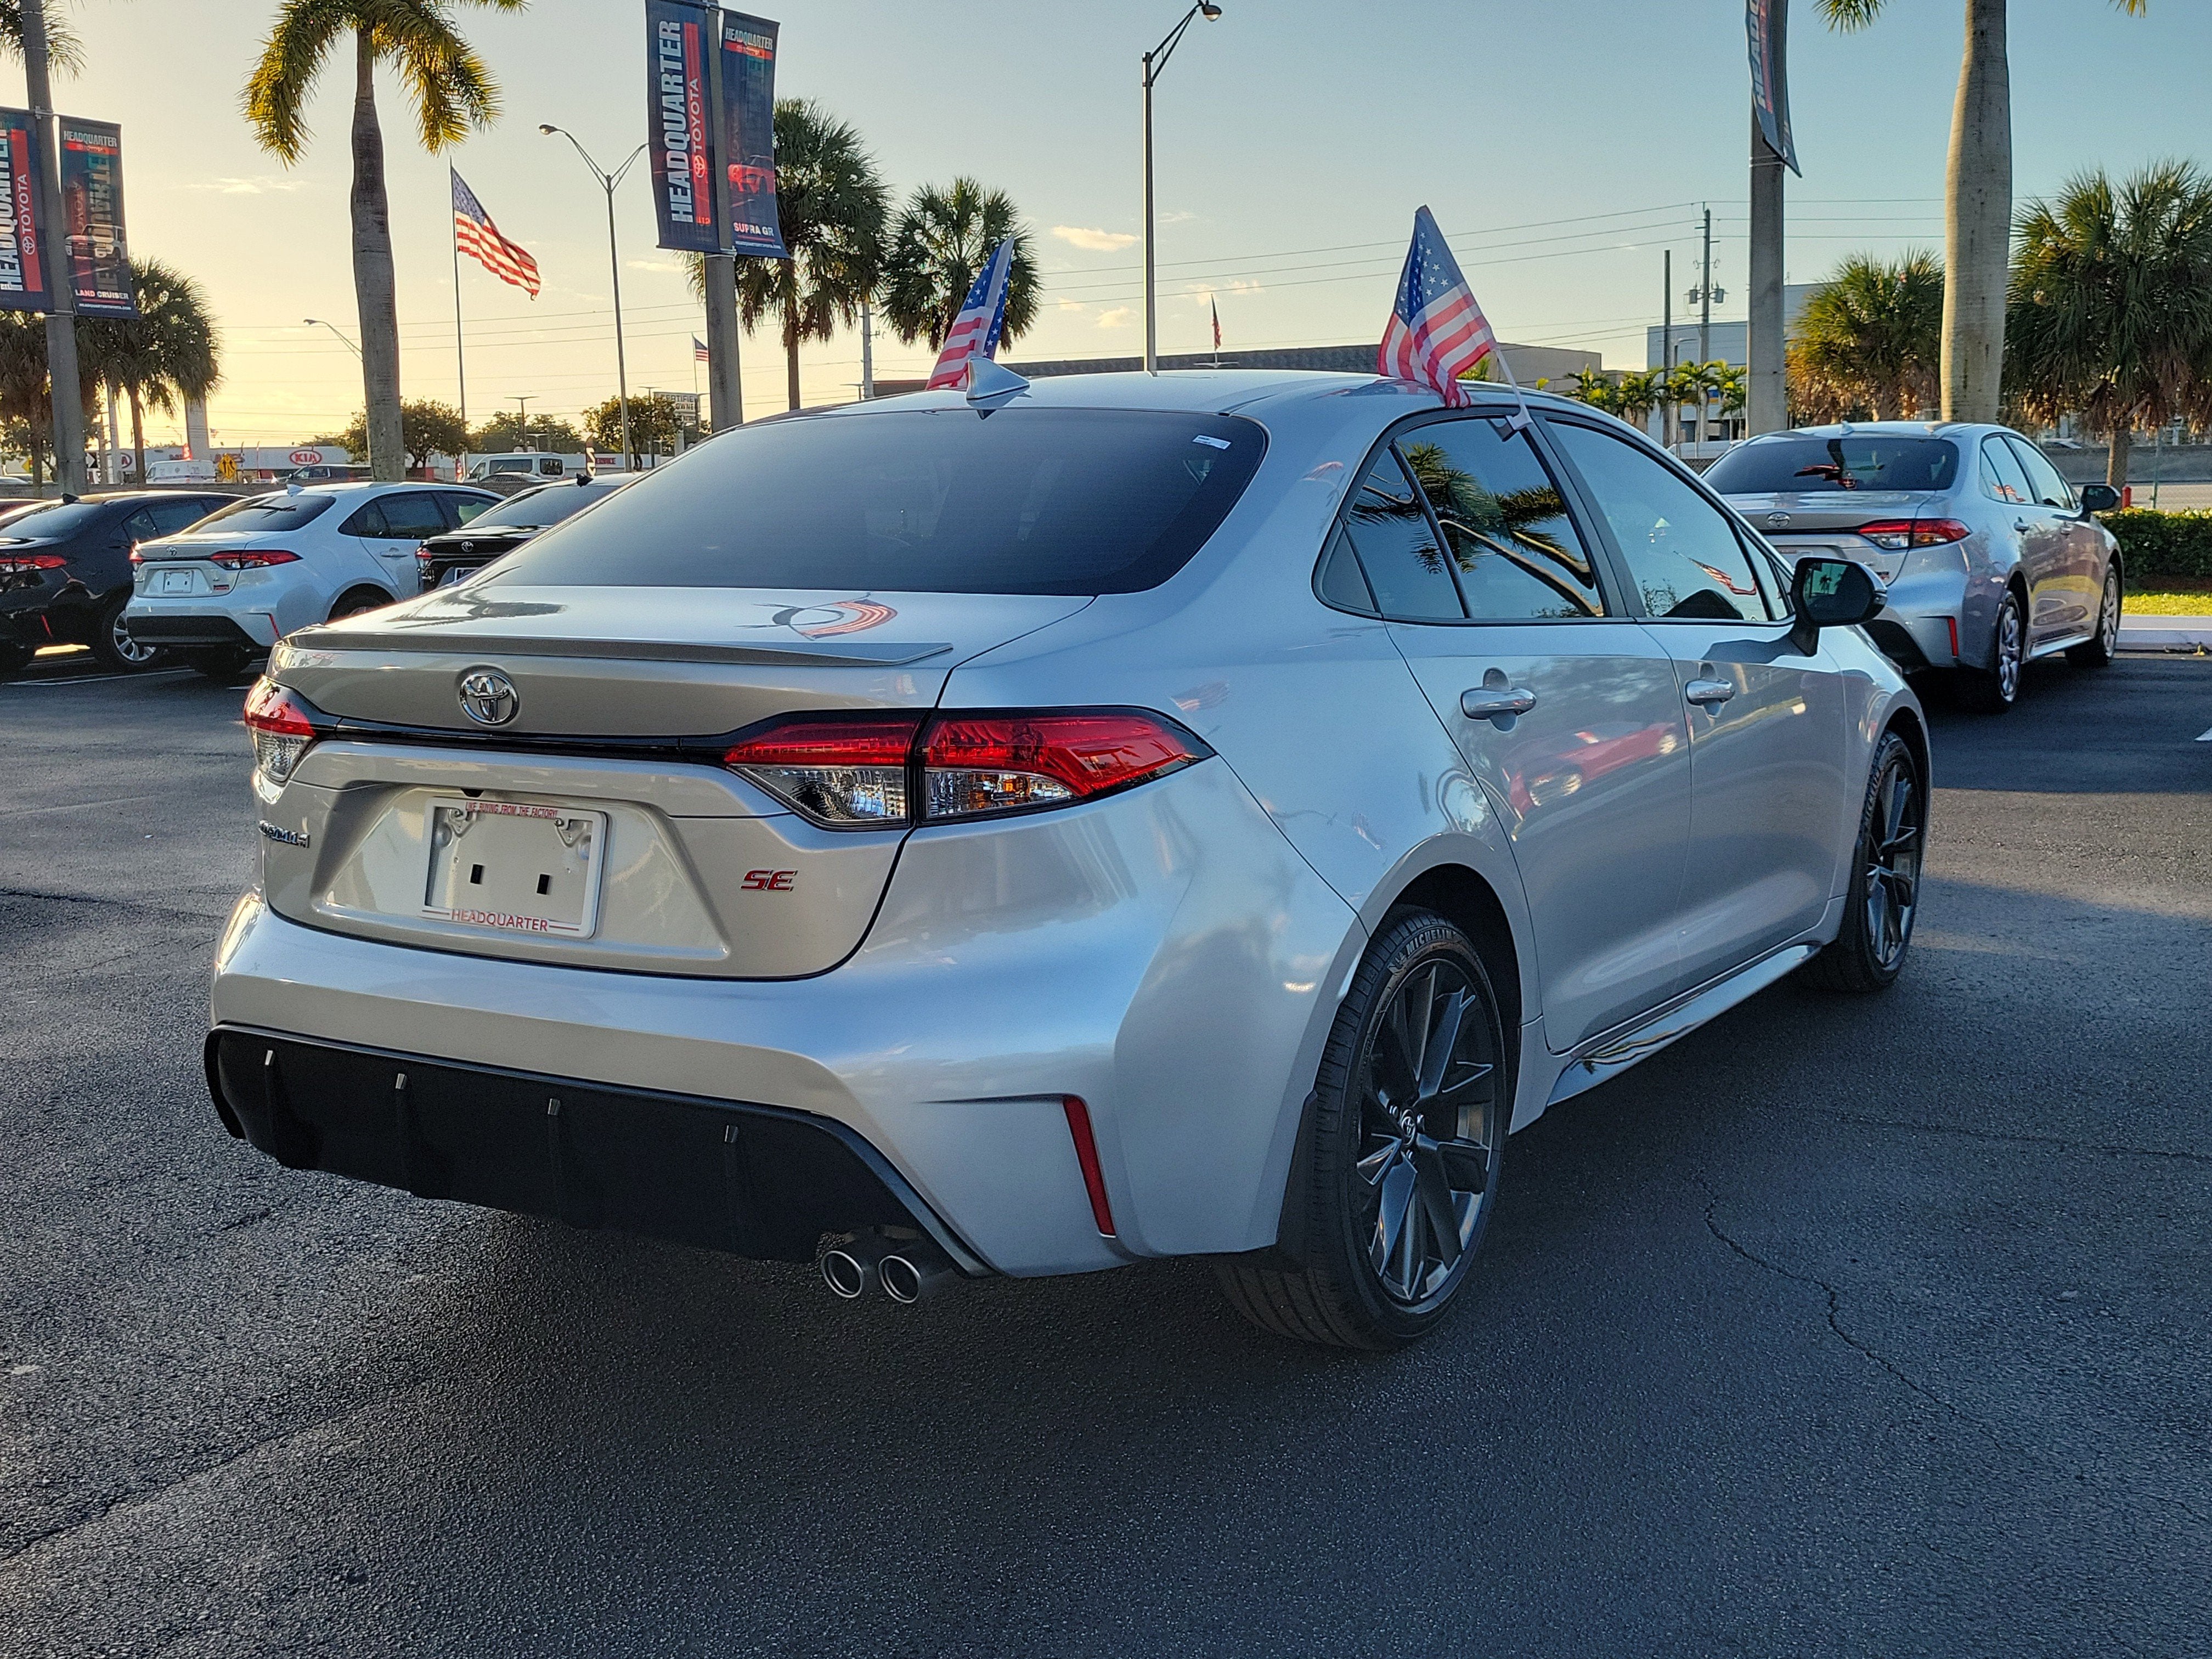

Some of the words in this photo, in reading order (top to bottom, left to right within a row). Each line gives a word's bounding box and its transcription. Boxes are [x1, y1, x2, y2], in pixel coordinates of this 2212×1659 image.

[725, 27, 773, 50] HEADQUARTER
[659, 20, 693, 222] HEADQUARTER
[689, 78, 702, 152] TOYOTA
[64, 131, 117, 147] HEADQUARTER
[18, 173, 32, 235] TOYOTA
[733, 222, 761, 235] SUPRA
[761, 226, 774, 236] GR
[75, 289, 95, 297] LAND
[97, 291, 129, 300] CRUISER
[295, 453, 318, 463] KIA
[501, 804, 517, 815] FROM
[519, 806, 529, 817] THE
[740, 868, 798, 892] SE
[450, 909, 548, 932] HEADQUARTER
[1406, 928, 1455, 956] MICHELIN
